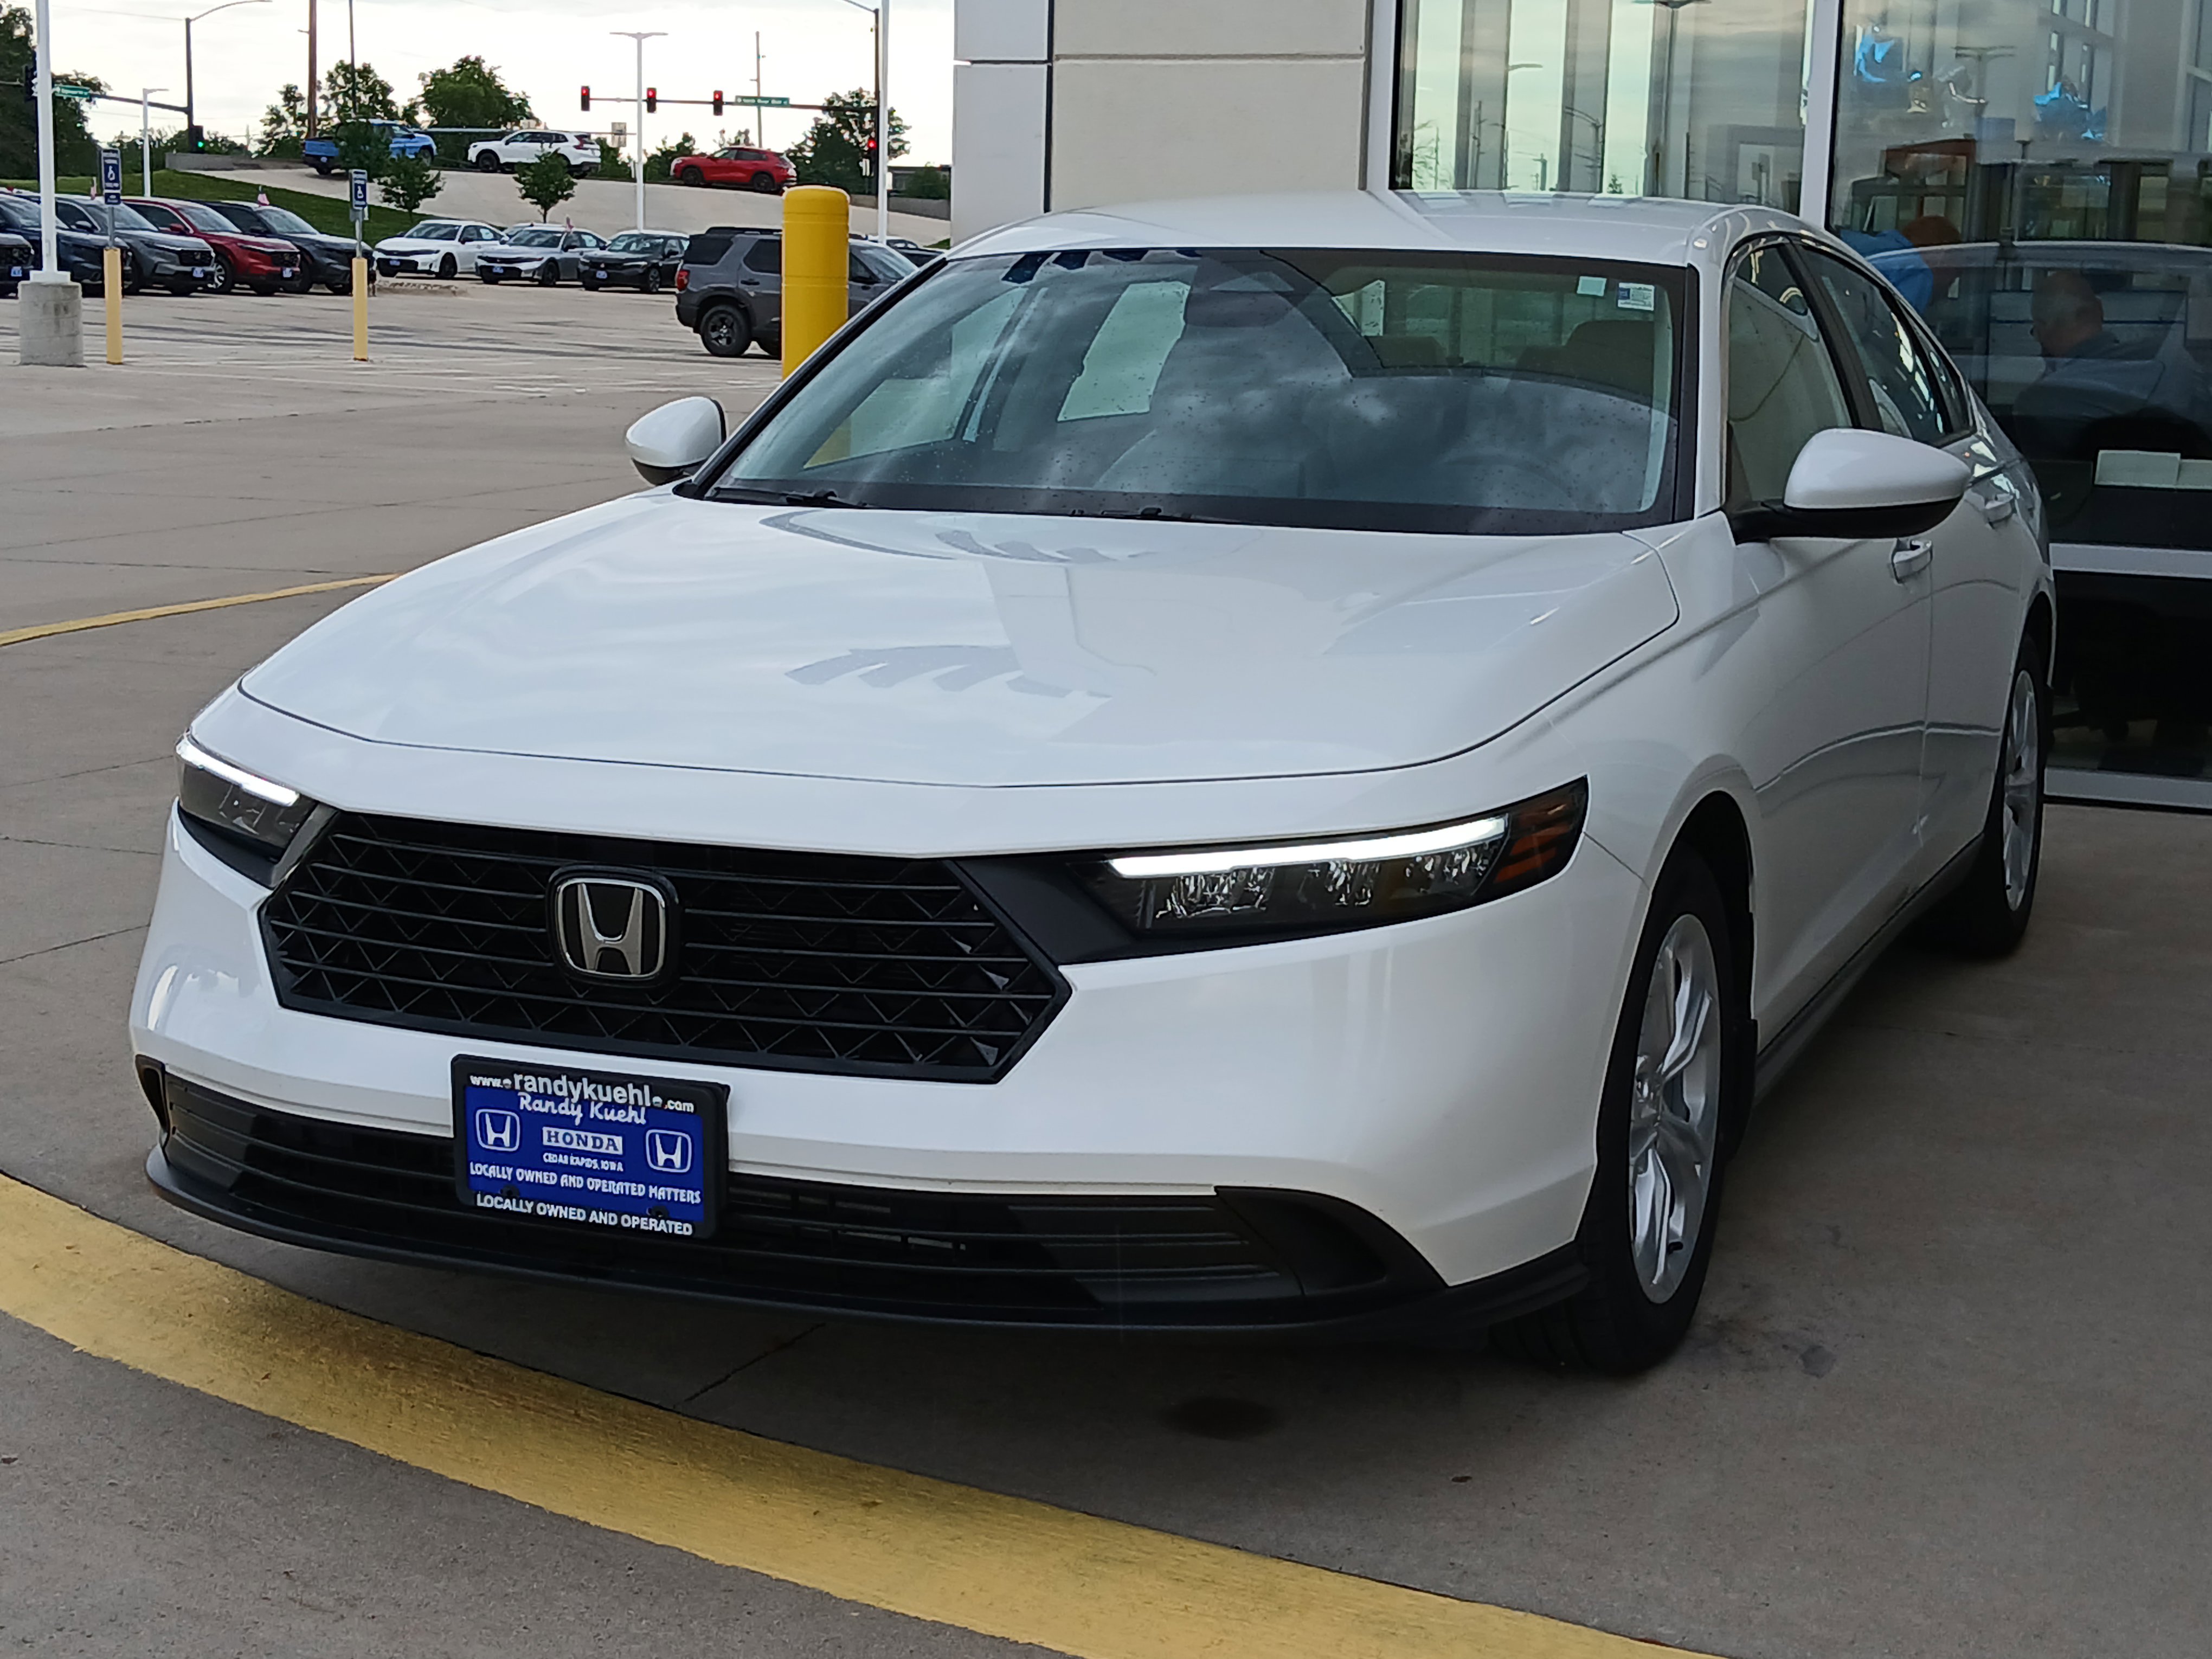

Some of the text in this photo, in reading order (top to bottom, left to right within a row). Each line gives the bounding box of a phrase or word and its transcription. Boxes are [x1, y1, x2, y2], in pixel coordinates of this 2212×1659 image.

[513, 1073, 651, 1107] randykuehl
[517, 1091, 647, 1126] Randy Kuehl
[546, 1130, 619, 1152] HONDA
[470, 1161, 702, 1204] LOCALLY OWNED AND OPERATED MATTERS
[477, 1193, 693, 1236] LOCALLY OWNED AND OPERATED
